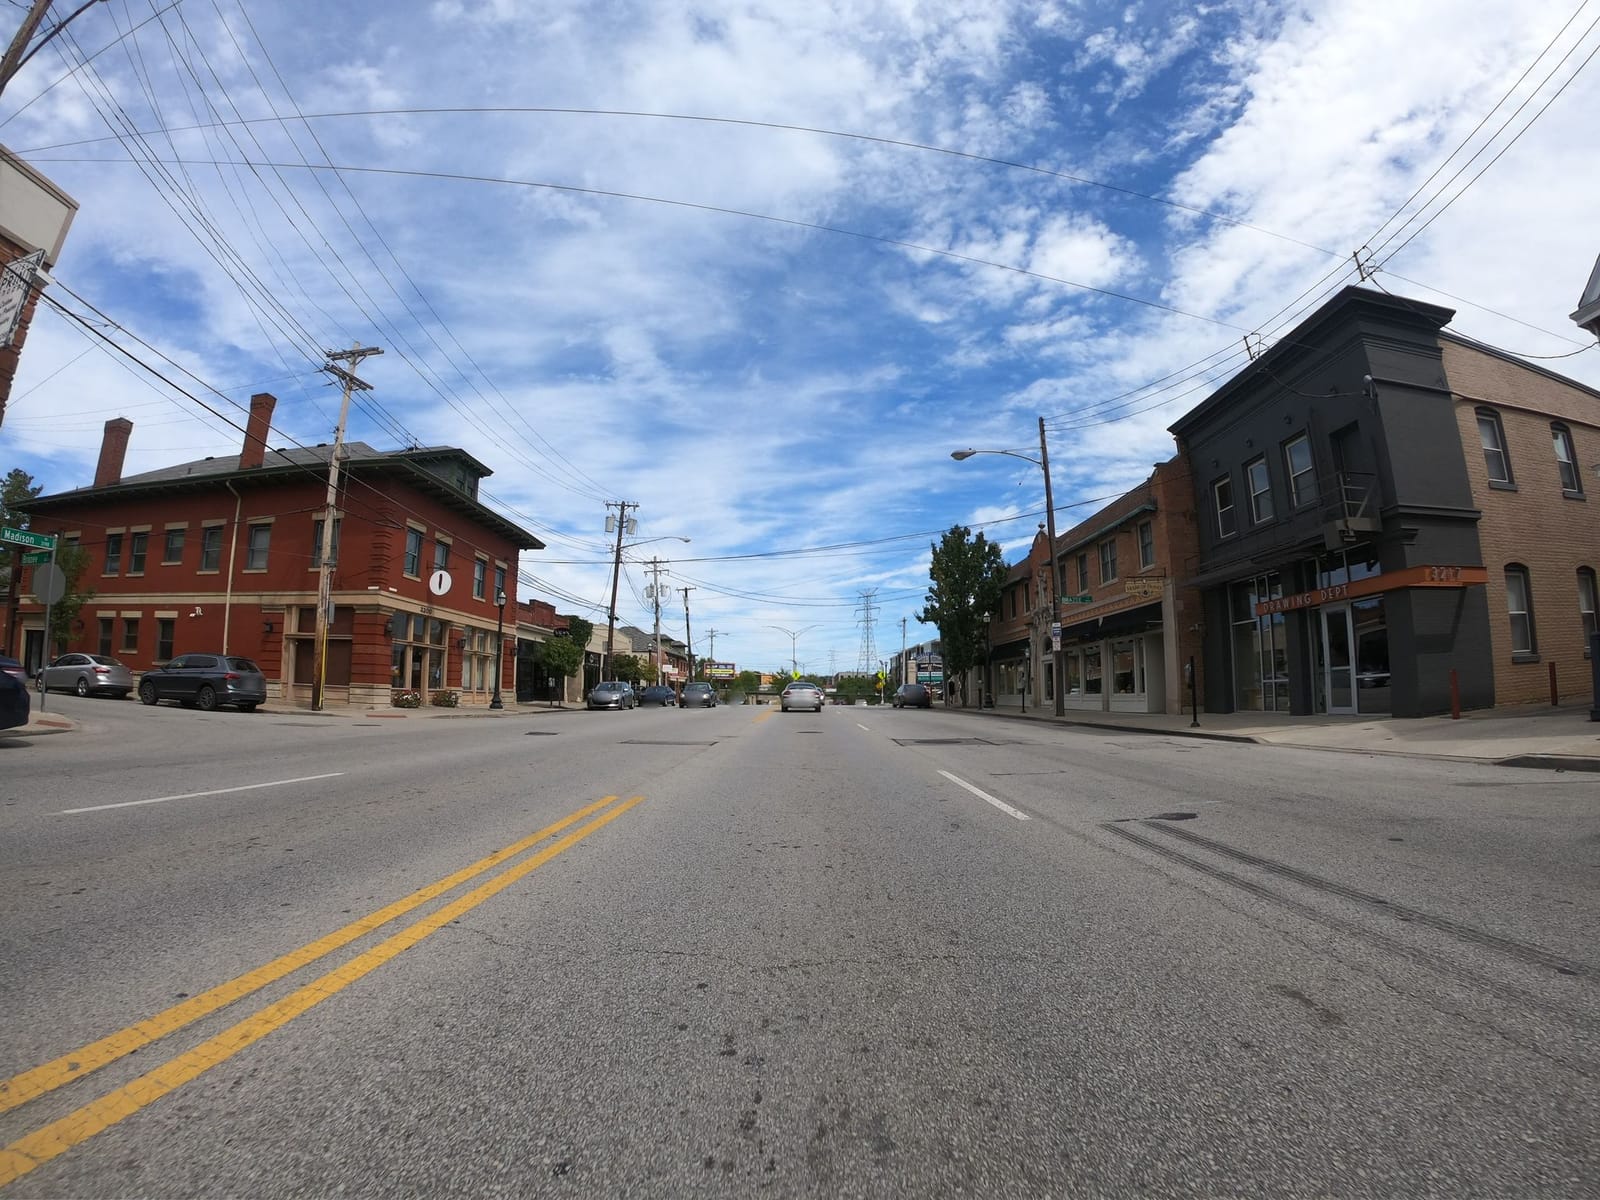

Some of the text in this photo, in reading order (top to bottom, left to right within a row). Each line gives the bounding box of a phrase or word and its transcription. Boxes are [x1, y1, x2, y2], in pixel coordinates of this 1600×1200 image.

[4, 530, 35, 544] Madison
[1431, 566, 1462, 580] 3217
[1263, 585, 1348, 613] DRAWING DEPT
